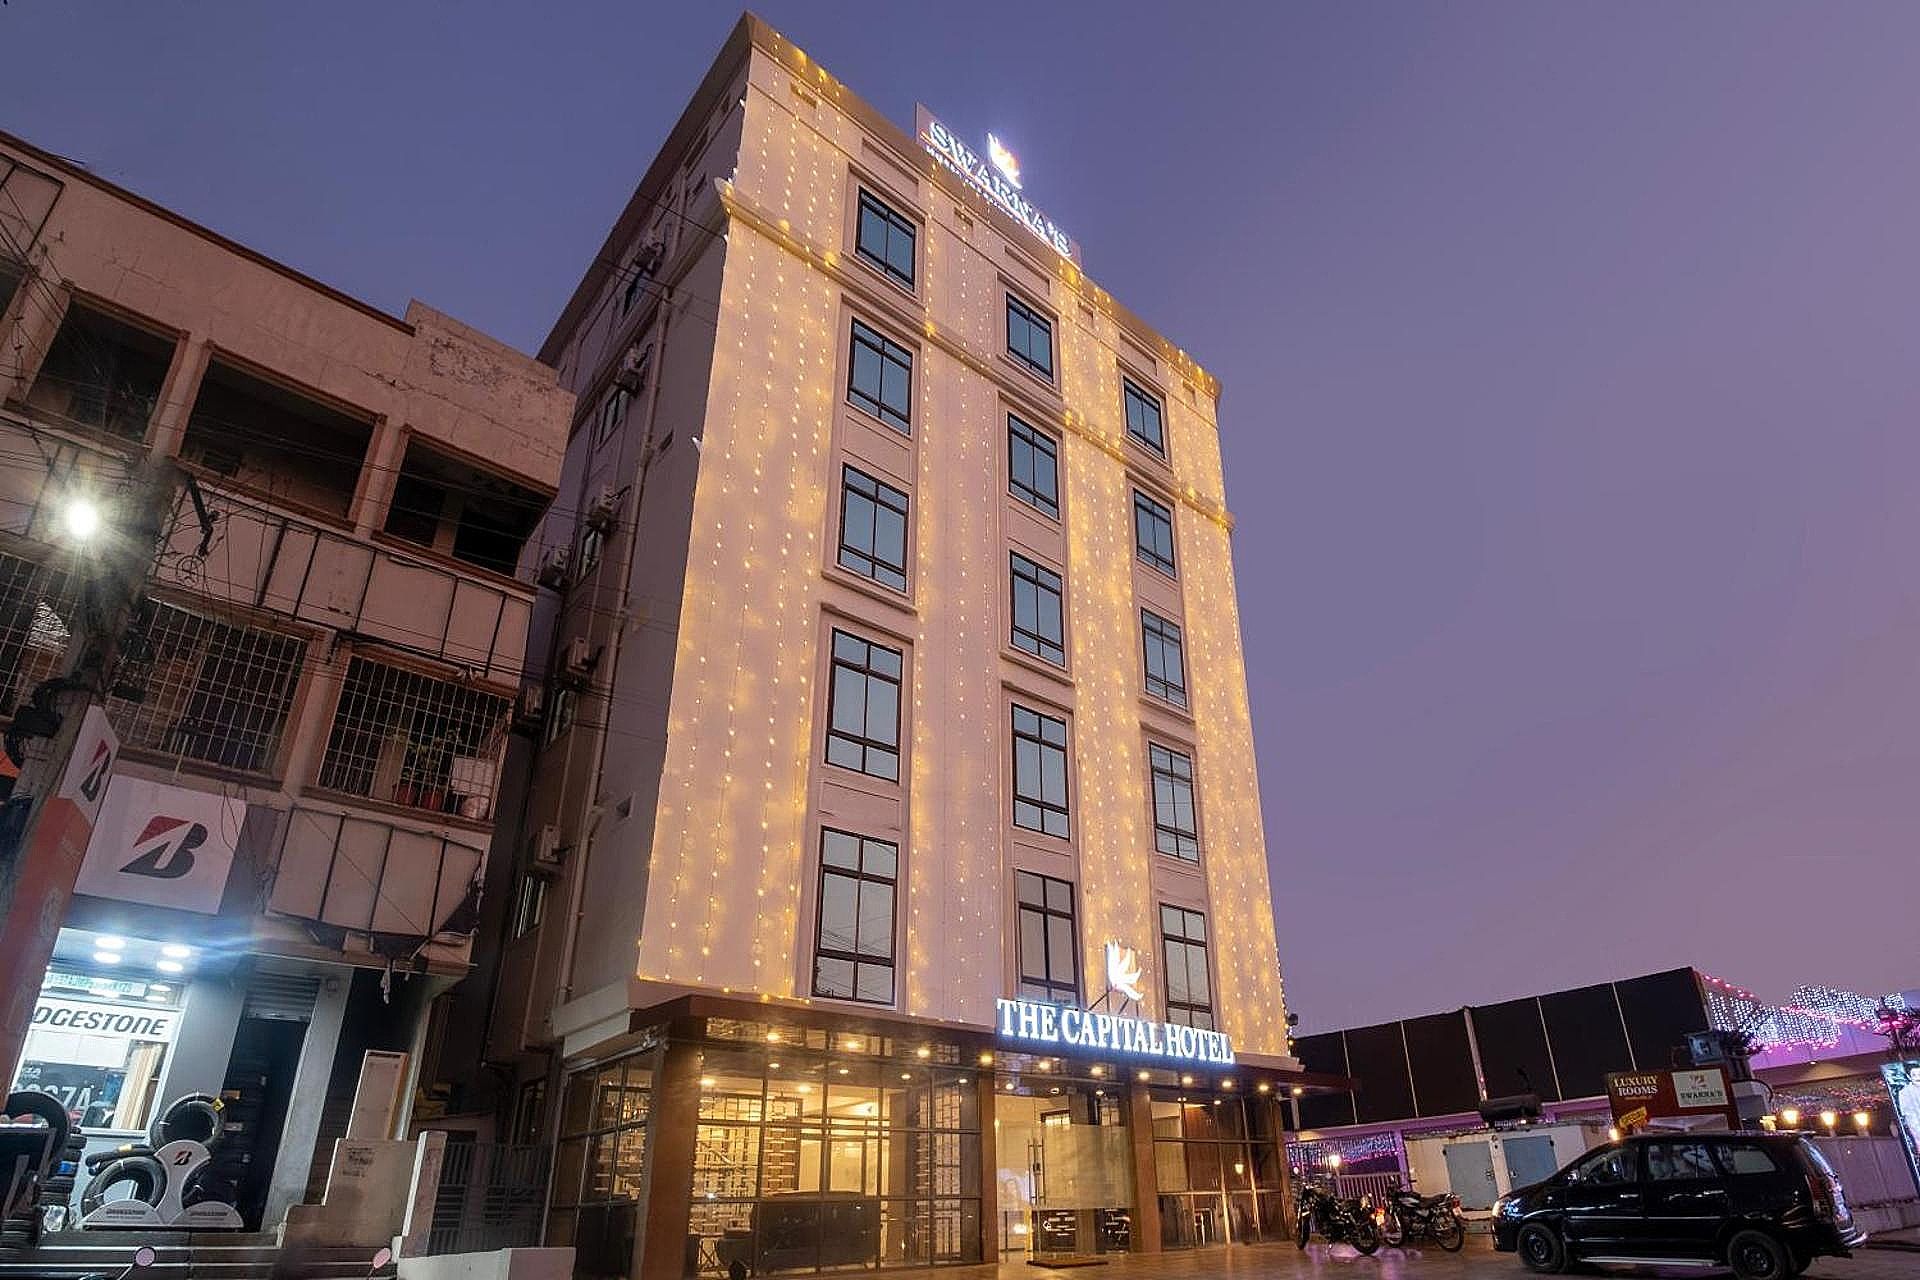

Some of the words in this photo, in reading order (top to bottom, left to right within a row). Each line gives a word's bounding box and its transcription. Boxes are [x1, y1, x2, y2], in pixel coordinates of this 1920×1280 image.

[929, 122, 1072, 256] SWARNA'S
[997, 998, 1058, 1042] THE
[1061, 1009, 1162, 1055] CAPITAL
[1163, 1022, 1235, 1064] HOTEL
[1613, 1075, 1658, 1087] LUXURY
[1618, 1085, 1659, 1096] ROOMS
